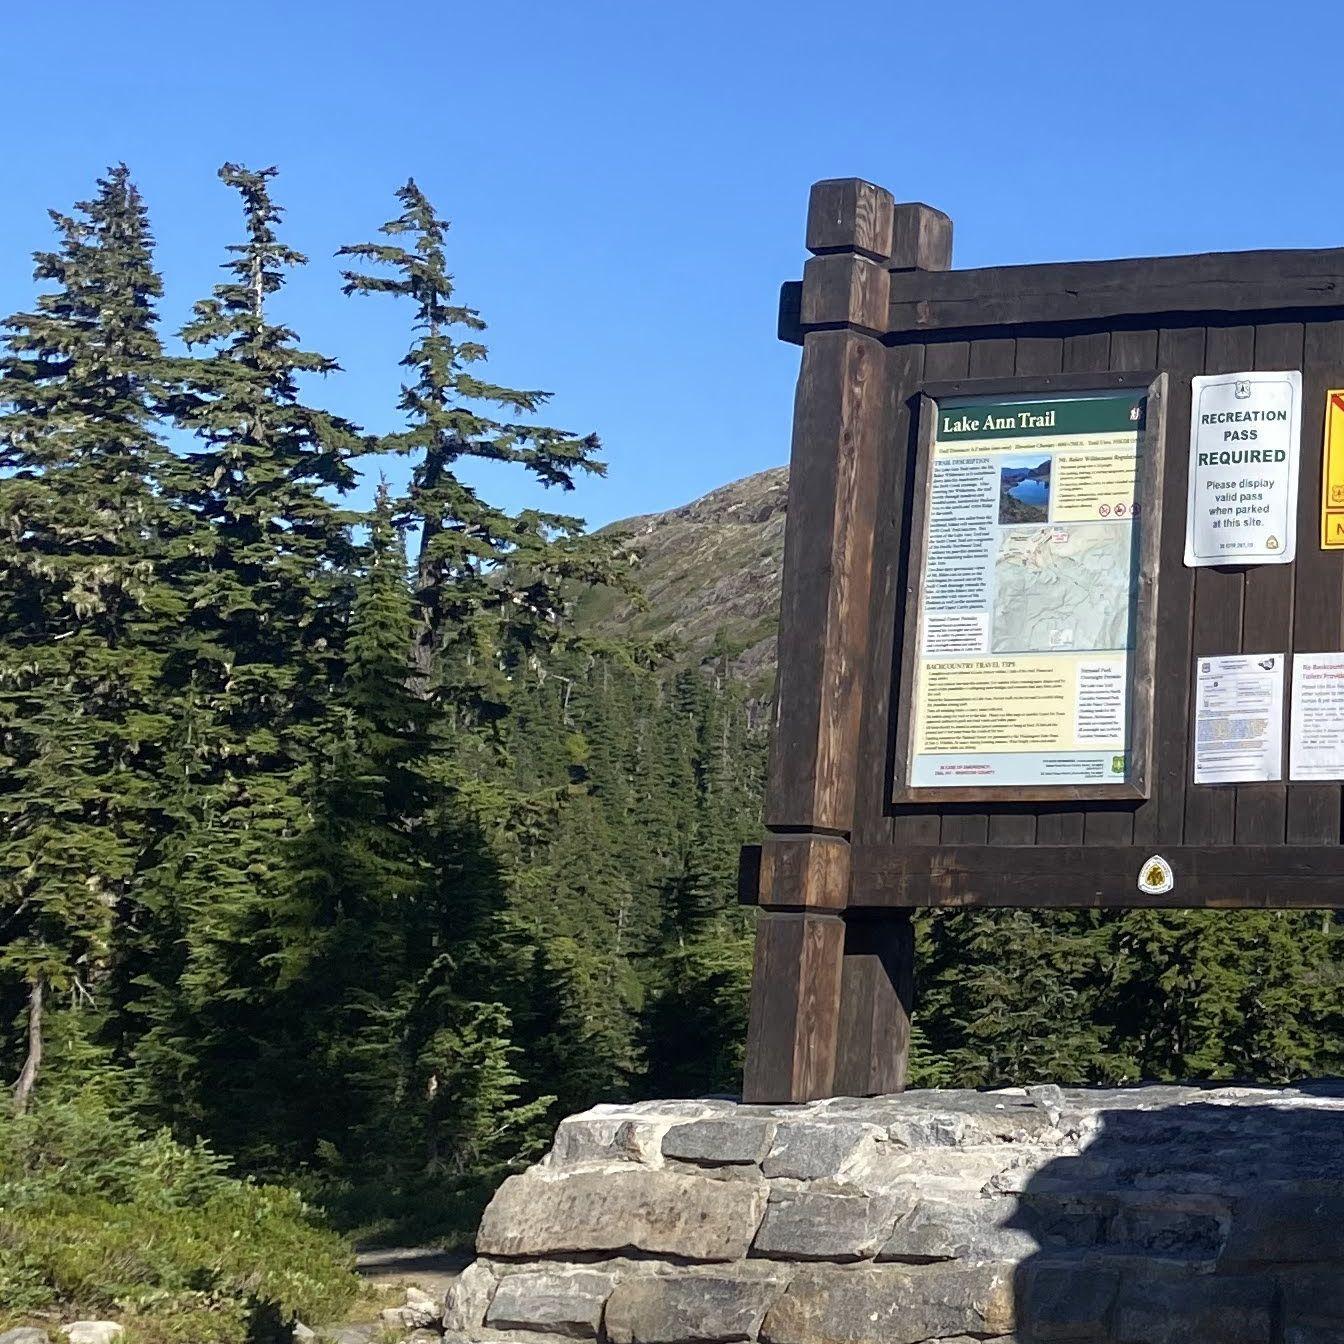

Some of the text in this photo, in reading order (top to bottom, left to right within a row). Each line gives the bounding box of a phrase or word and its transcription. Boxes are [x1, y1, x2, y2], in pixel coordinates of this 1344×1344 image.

[943, 411, 1055, 433] Lake Ann Trail
[1201, 410, 1287, 424] RECREATION
[1223, 430, 1258, 441] PASS
[1198, 449, 1286, 466] REQUIRED
[1206, 479, 1275, 490] Please display
[1215, 492, 1263, 503] valid pass
[1208, 504, 1270, 516] when parked
[1212, 517, 1264, 528] at this site.
